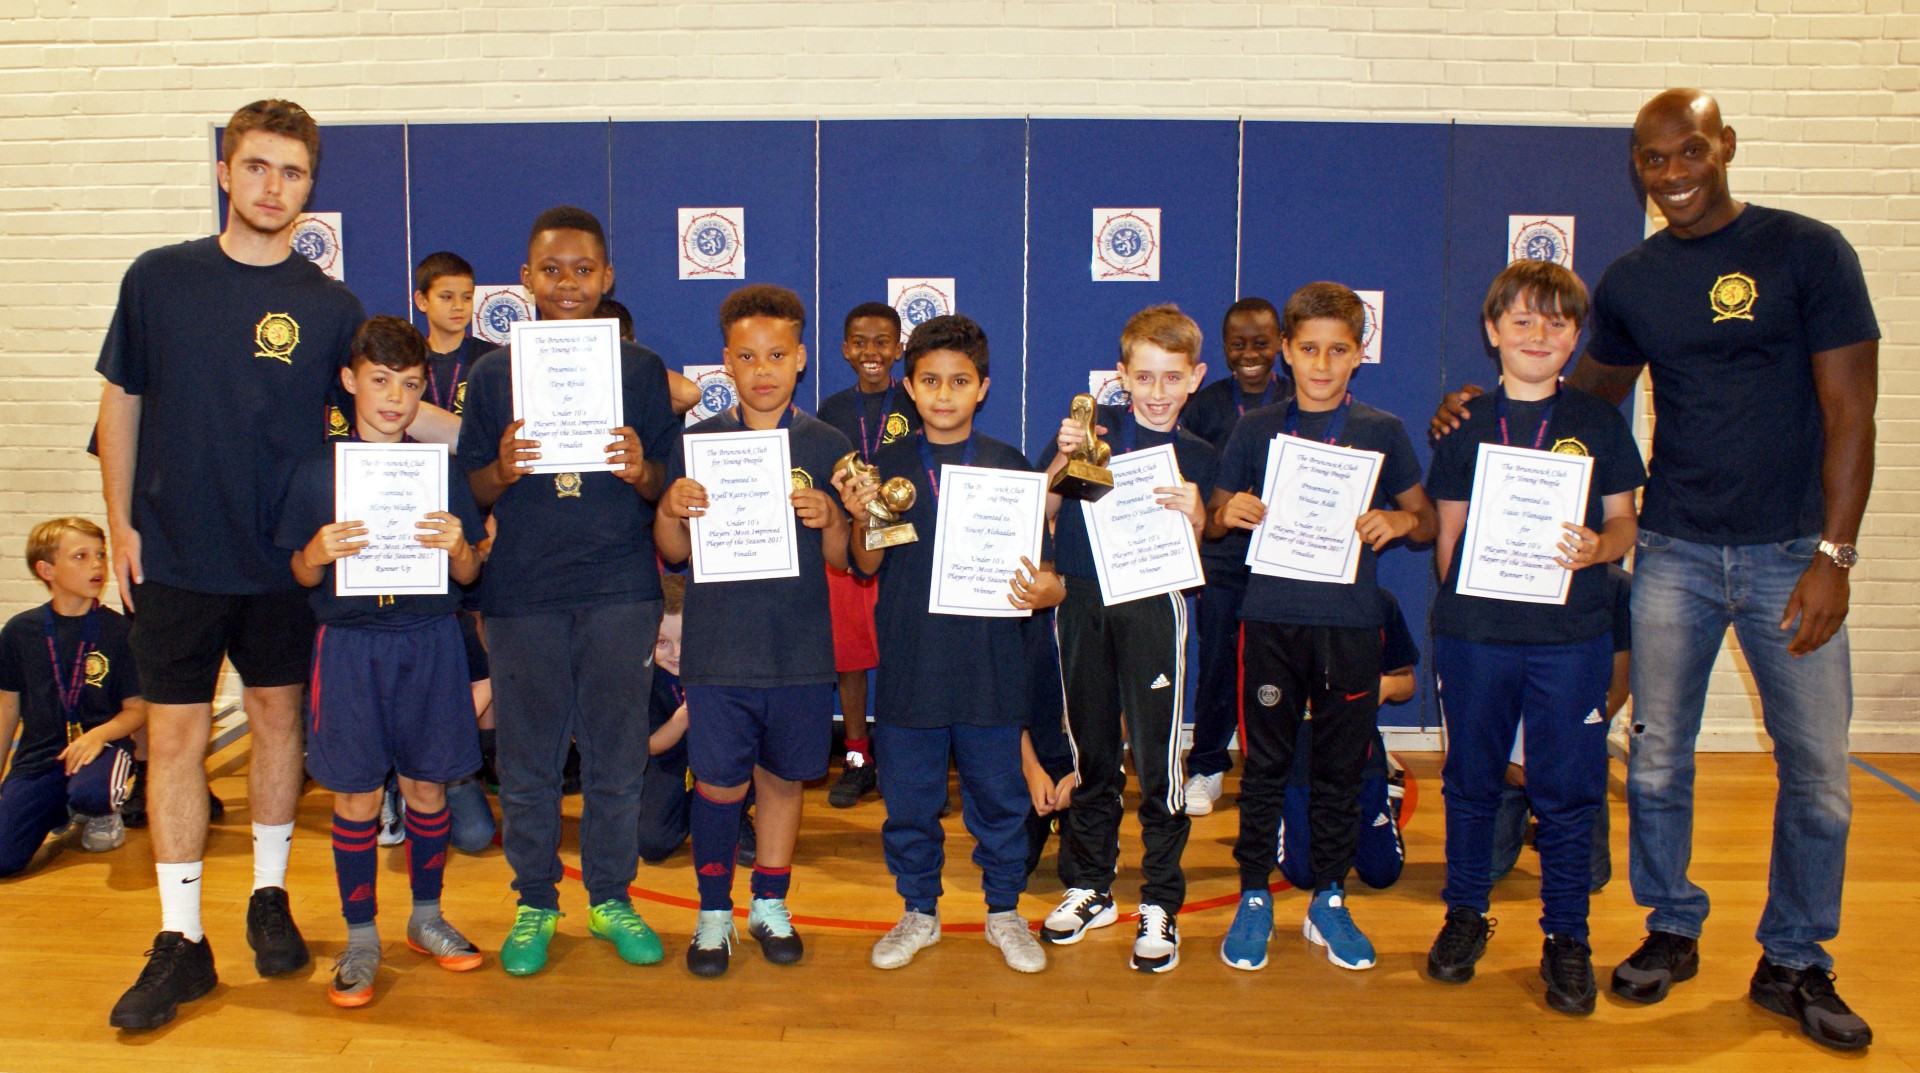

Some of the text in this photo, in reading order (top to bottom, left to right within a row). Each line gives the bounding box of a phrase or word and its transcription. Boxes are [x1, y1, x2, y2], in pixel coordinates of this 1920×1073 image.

[561, 394, 572, 403] for
[530, 430, 550, 438] Player
[711, 458, 720, 466] for
[1309, 457, 1341, 468] Brunswick
[399, 470, 419, 478] People
[1114, 464, 1156, 477] runswick Club
[1311, 467, 1329, 476] Young
[1331, 470, 1350, 479] People
[1515, 465, 1549, 474] Brunswick
[1116, 479, 1133, 487] Young
[1503, 473, 1559, 487] for Young People
[1302, 483, 1332, 493] Presented
[964, 492, 976, 500] for
[999, 496, 1018, 504] People
[1116, 494, 1143, 505] Presented
[1510, 494, 1542, 504] Presented
[735, 504, 745, 513] for
[973, 513, 1002, 521] Presented
[386, 518, 398, 527] for
[1135, 523, 1144, 532] for
[1518, 525, 1530, 533] for
[1127, 538, 1146, 546] Under
[1268, 532, 1287, 540] Player
[1308, 541, 1327, 549] Season
[1315, 535, 1344, 543] Improved
[982, 541, 993, 550] for
[1153, 539, 1180, 550] Improved
[1170, 547, 1184, 555] 2017
[1291, 549, 1314, 558] Finalist
[1510, 549, 1527, 557] Most
[351, 552, 372, 561] Player
[947, 572, 966, 580] Player
[1499, 570, 1522, 578] Runner
